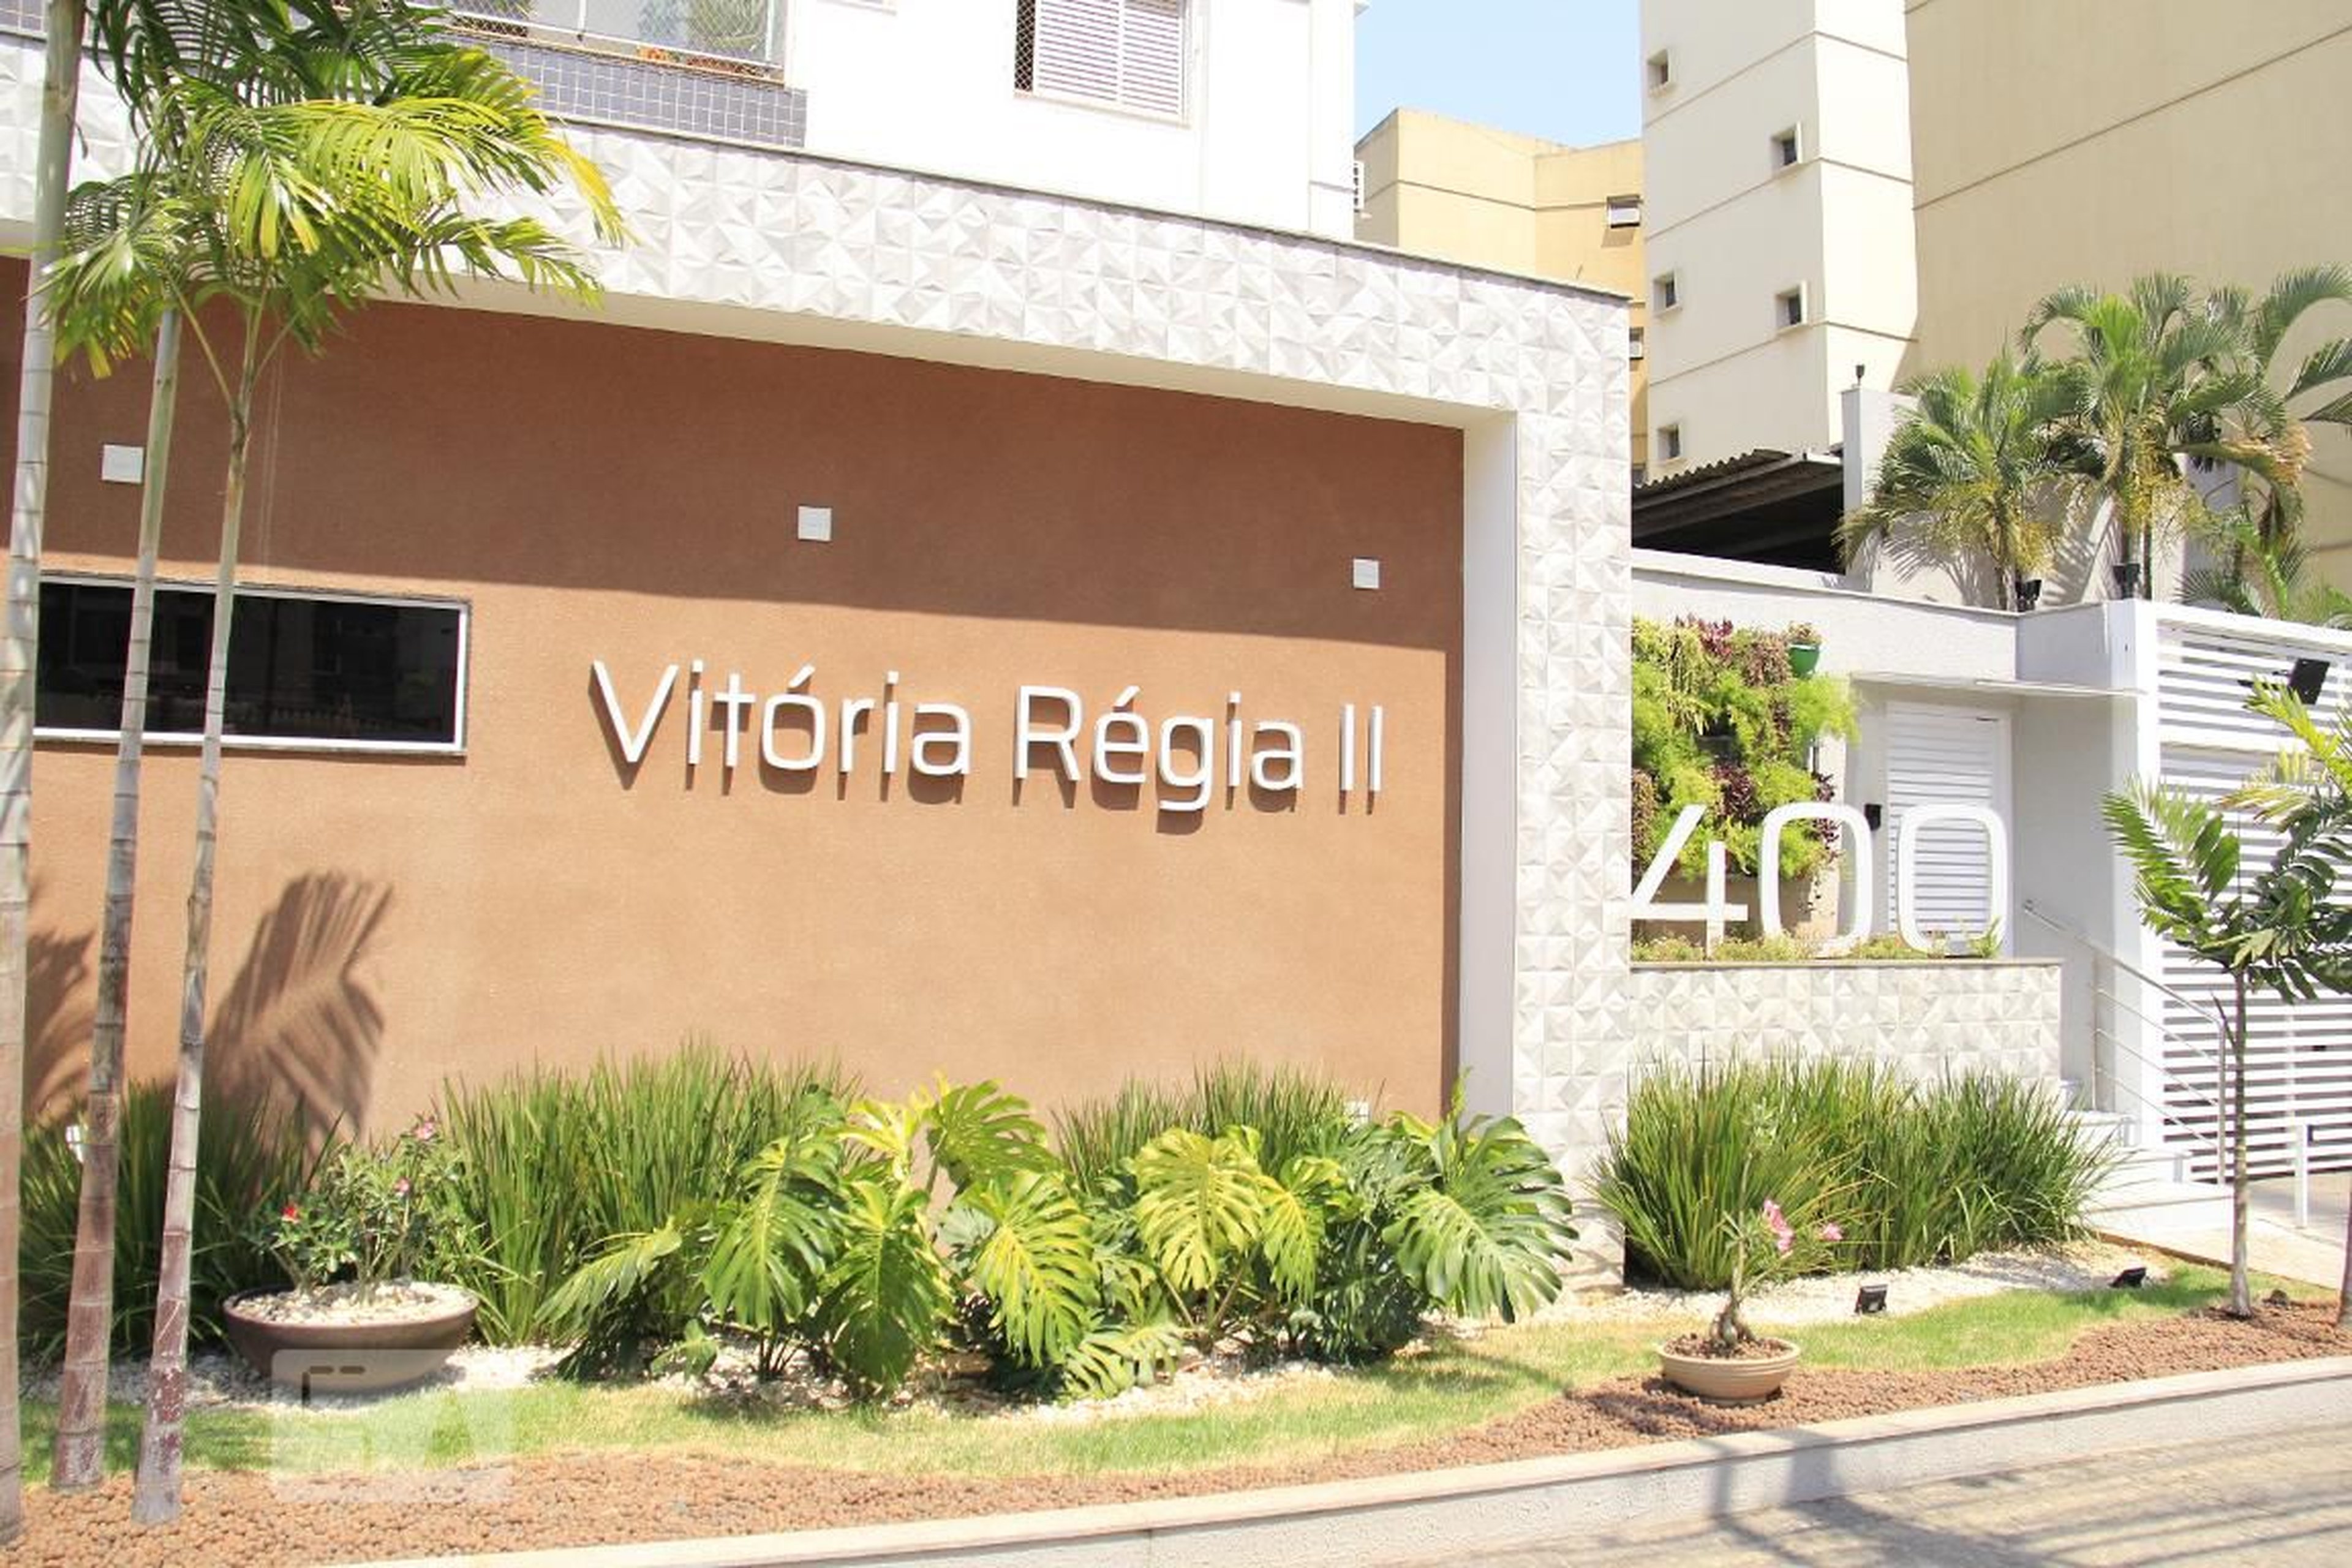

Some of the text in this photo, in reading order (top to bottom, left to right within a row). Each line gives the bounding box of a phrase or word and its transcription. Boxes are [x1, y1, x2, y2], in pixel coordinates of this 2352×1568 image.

[591, 660, 1384, 812] Vitória Régia II
[1602, 802, 2008, 958] 400
